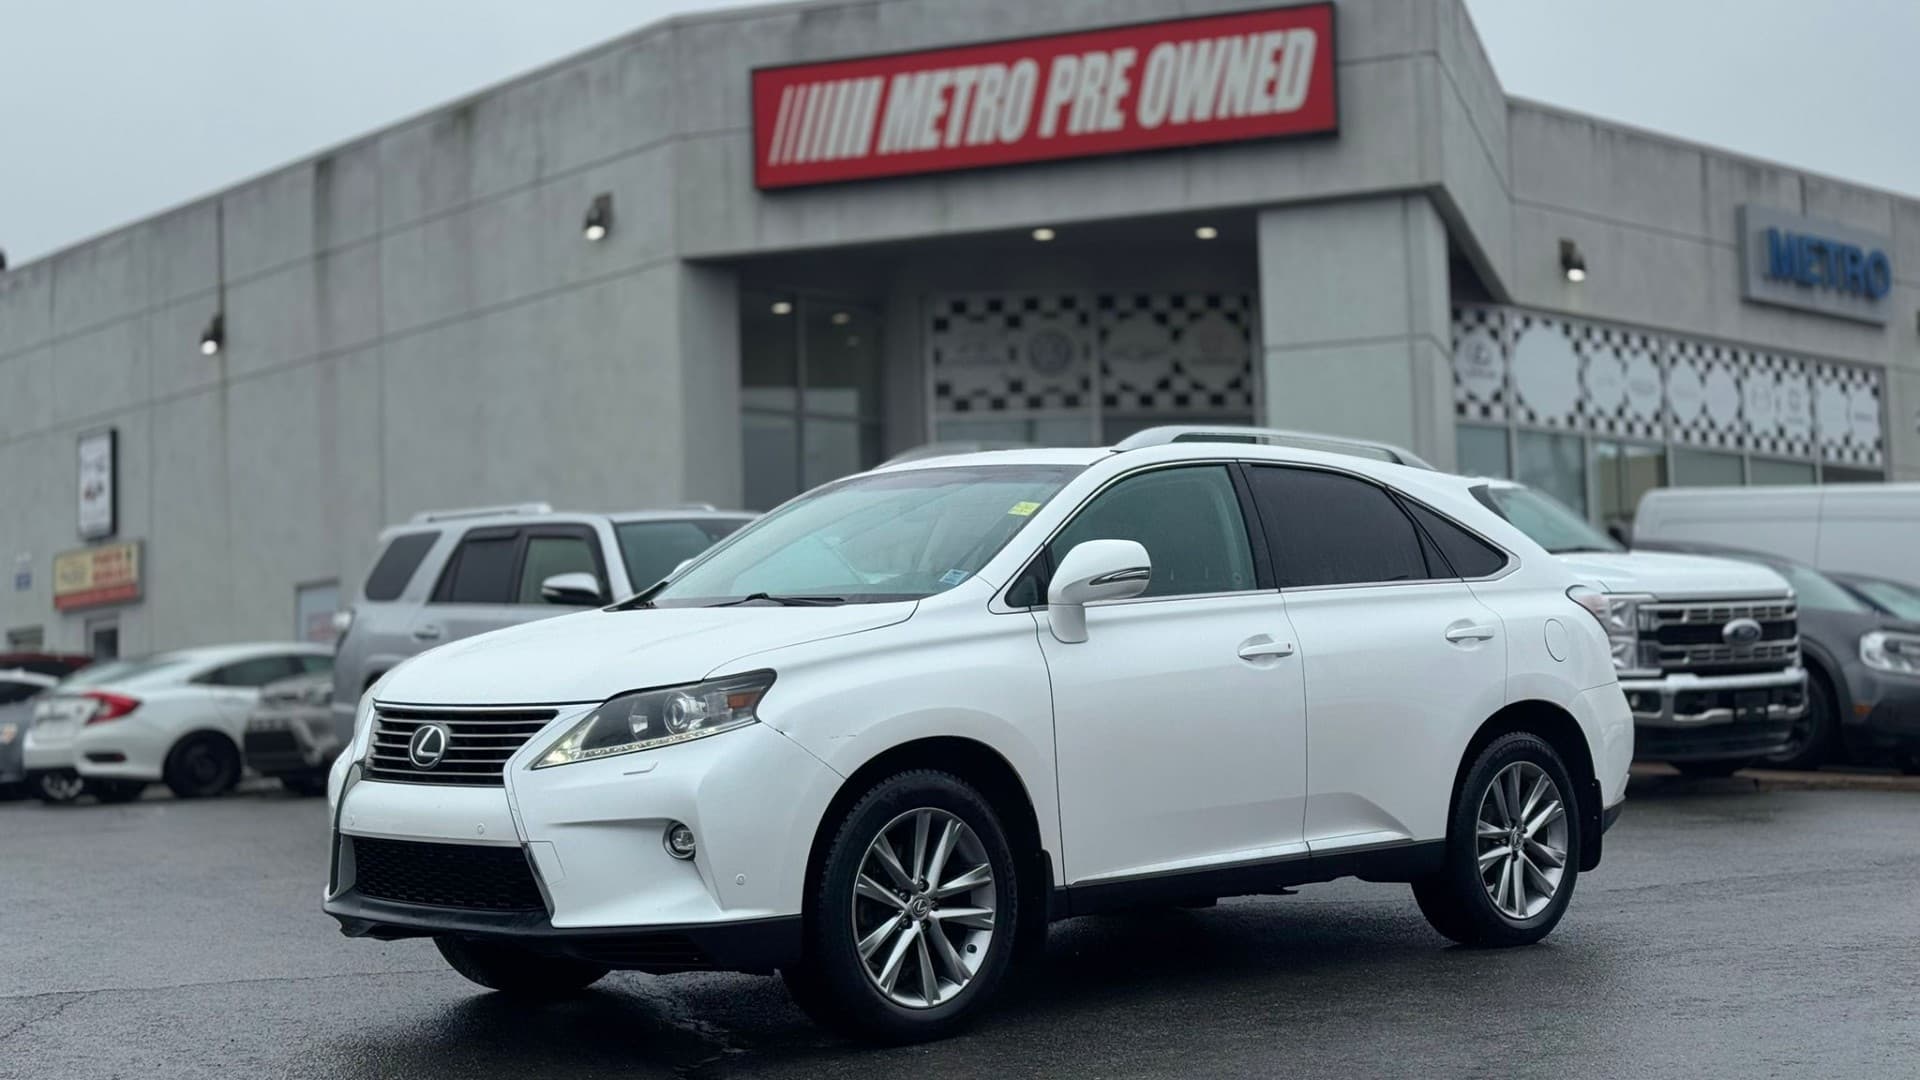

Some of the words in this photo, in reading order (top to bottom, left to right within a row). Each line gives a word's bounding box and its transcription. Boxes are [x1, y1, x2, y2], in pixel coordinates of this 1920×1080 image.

[878, 58, 1039, 155] METRO
[1038, 48, 1137, 138] PRE
[1137, 28, 1317, 130] OWNED
[1766, 226, 1891, 299] METRO
